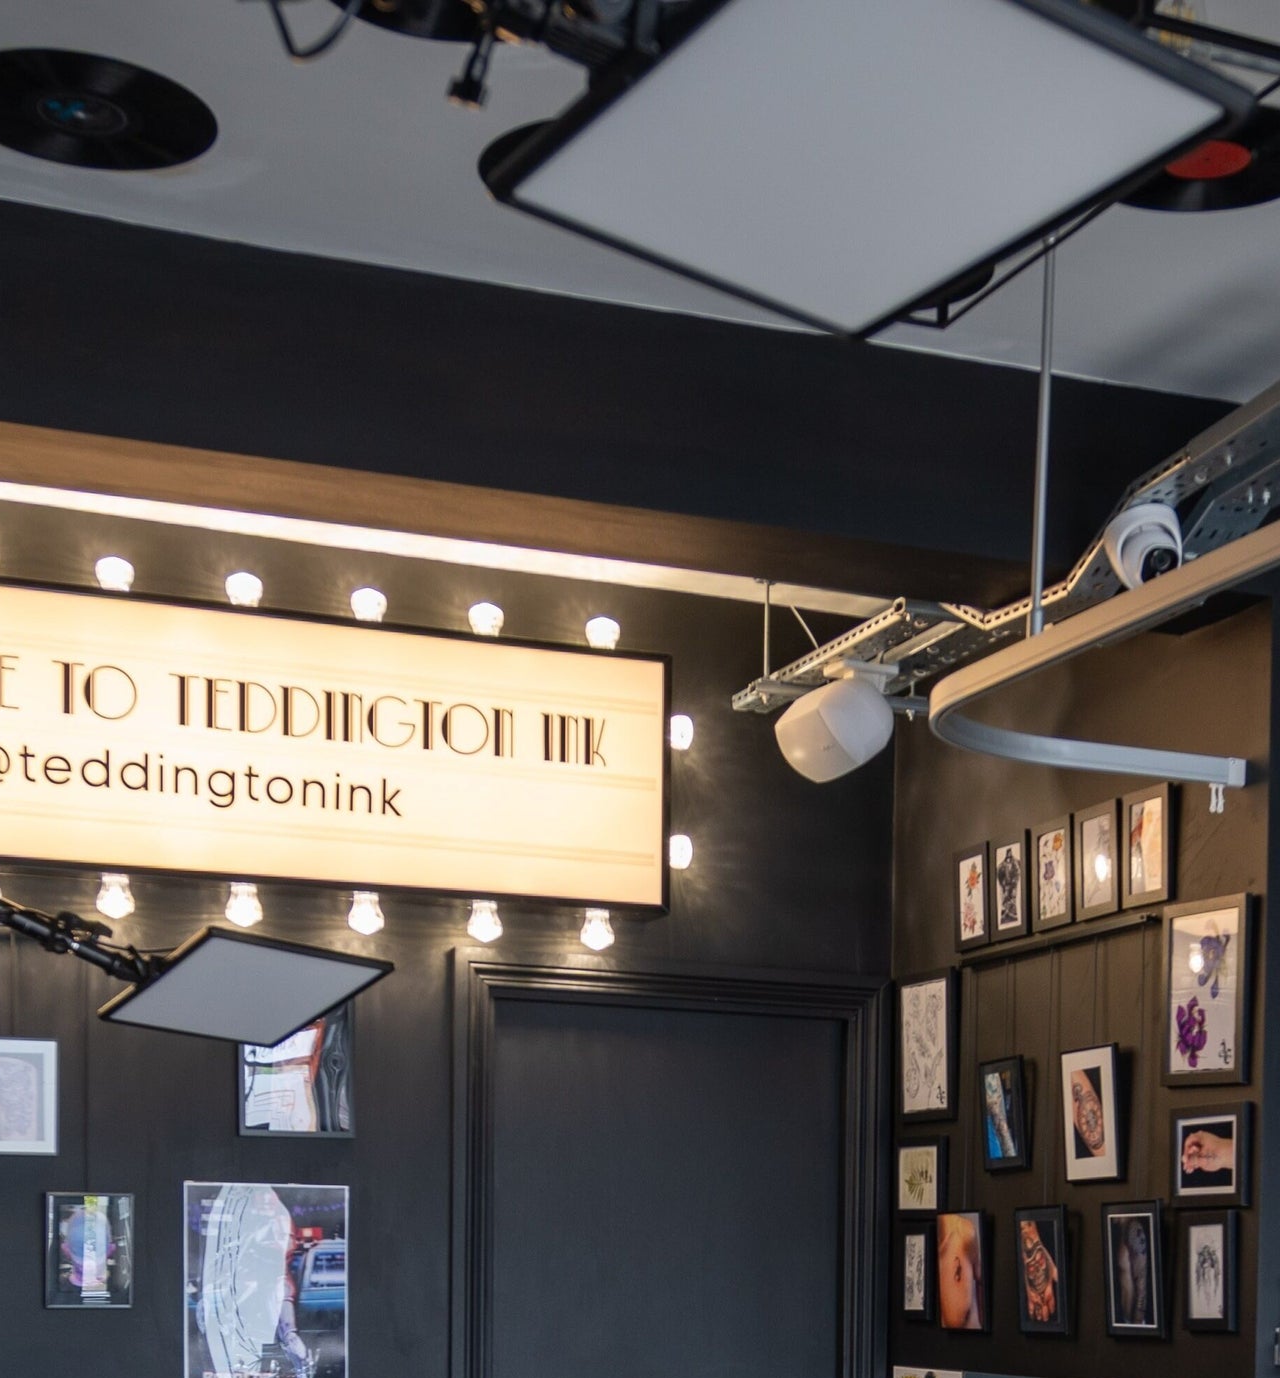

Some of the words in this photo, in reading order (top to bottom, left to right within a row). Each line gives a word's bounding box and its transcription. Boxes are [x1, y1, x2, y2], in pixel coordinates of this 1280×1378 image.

[51, 659, 138, 720] TO
[168, 671, 514, 759] TEDDINGTON
[540, 711, 607, 767] INK
